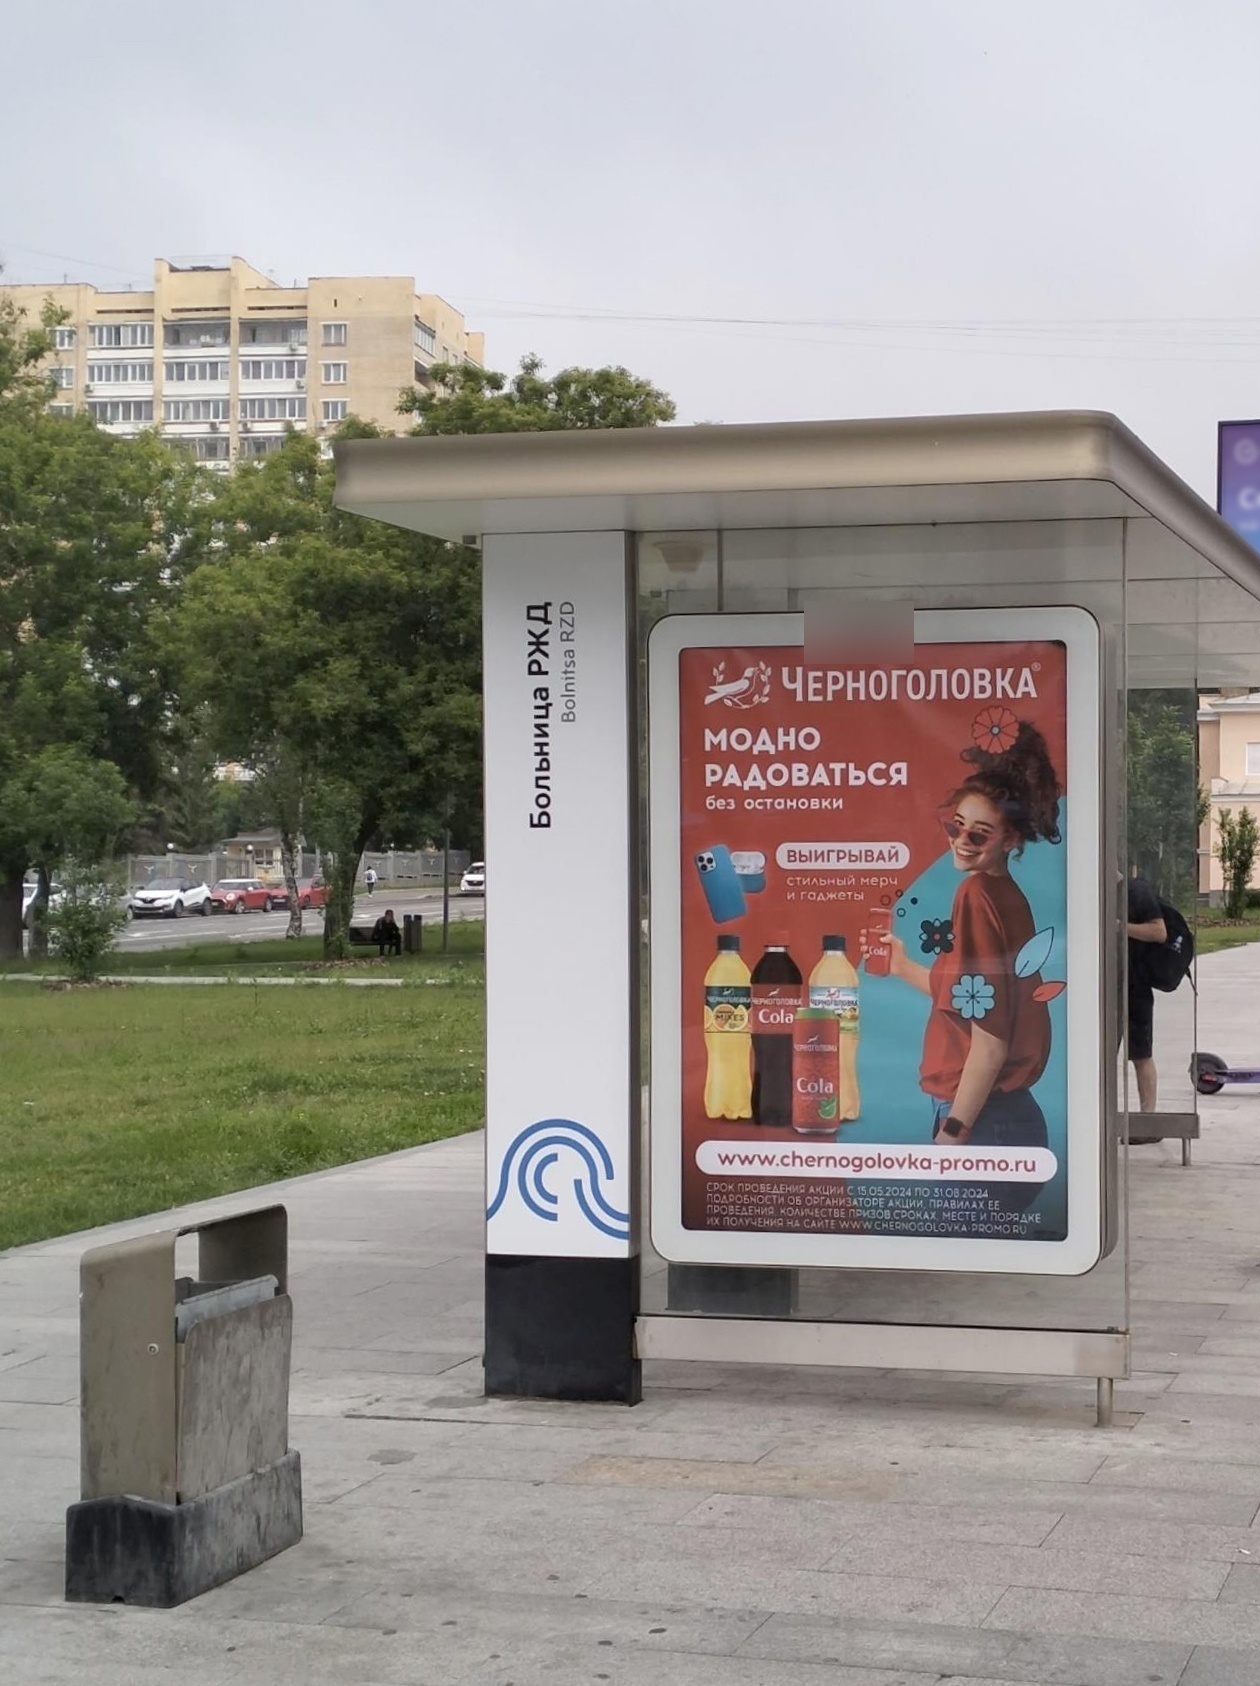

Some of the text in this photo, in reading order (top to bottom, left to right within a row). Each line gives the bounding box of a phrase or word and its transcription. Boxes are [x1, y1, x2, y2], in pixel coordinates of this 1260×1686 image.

[559, 601, 576, 723] Bolnitsa RZD
[526, 601, 553, 829] Больница РЖД
[704, 726, 821, 755] МОДНО
[704, 761, 908, 791] РАДОВАТЬСЯ
[705, 794, 843, 810] без остановки
[786, 845, 899, 864] ВЫИГРЫВАЙ
[786, 874, 898, 888] стильный мерч
[786, 890, 864, 902] и гаджеты
[758, 1008, 794, 1024] Cola
[796, 1076, 834, 1094] Cola
[717, 1150, 1036, 1175] www.chernogolovka-promo.ru
[706, 1182, 735, 1192] СРОК
[737, 1182, 806, 1194] ПРОВЕДЕНИЯ
[808, 1184, 844, 1196] АКЦИИ
[914, 1187, 930, 1197] ПО
[706, 1193, 785, 1205] ПОДРОБНОСТИ
[787, 1196, 802, 1206] ОБ
[804, 1196, 885, 1208] ОРГАНИЗАТОРЕ
[929, 1199, 985, 1210] ПРАВИЛАХ
[706, 1216, 720, 1226] ИХ
[722, 1216, 784, 1228] ПОЛУЧЕНИЯ
[786, 1218, 801, 1228] НА
[803, 1217, 836, 1230] САЙТЕ
[780, 1207, 846, 1218] КОЛИЧЕСТВЕ
[942, 1211, 977, 1222] МЕСТЕ
[990, 1212, 1042, 1224] ПОРЯДКЕ
